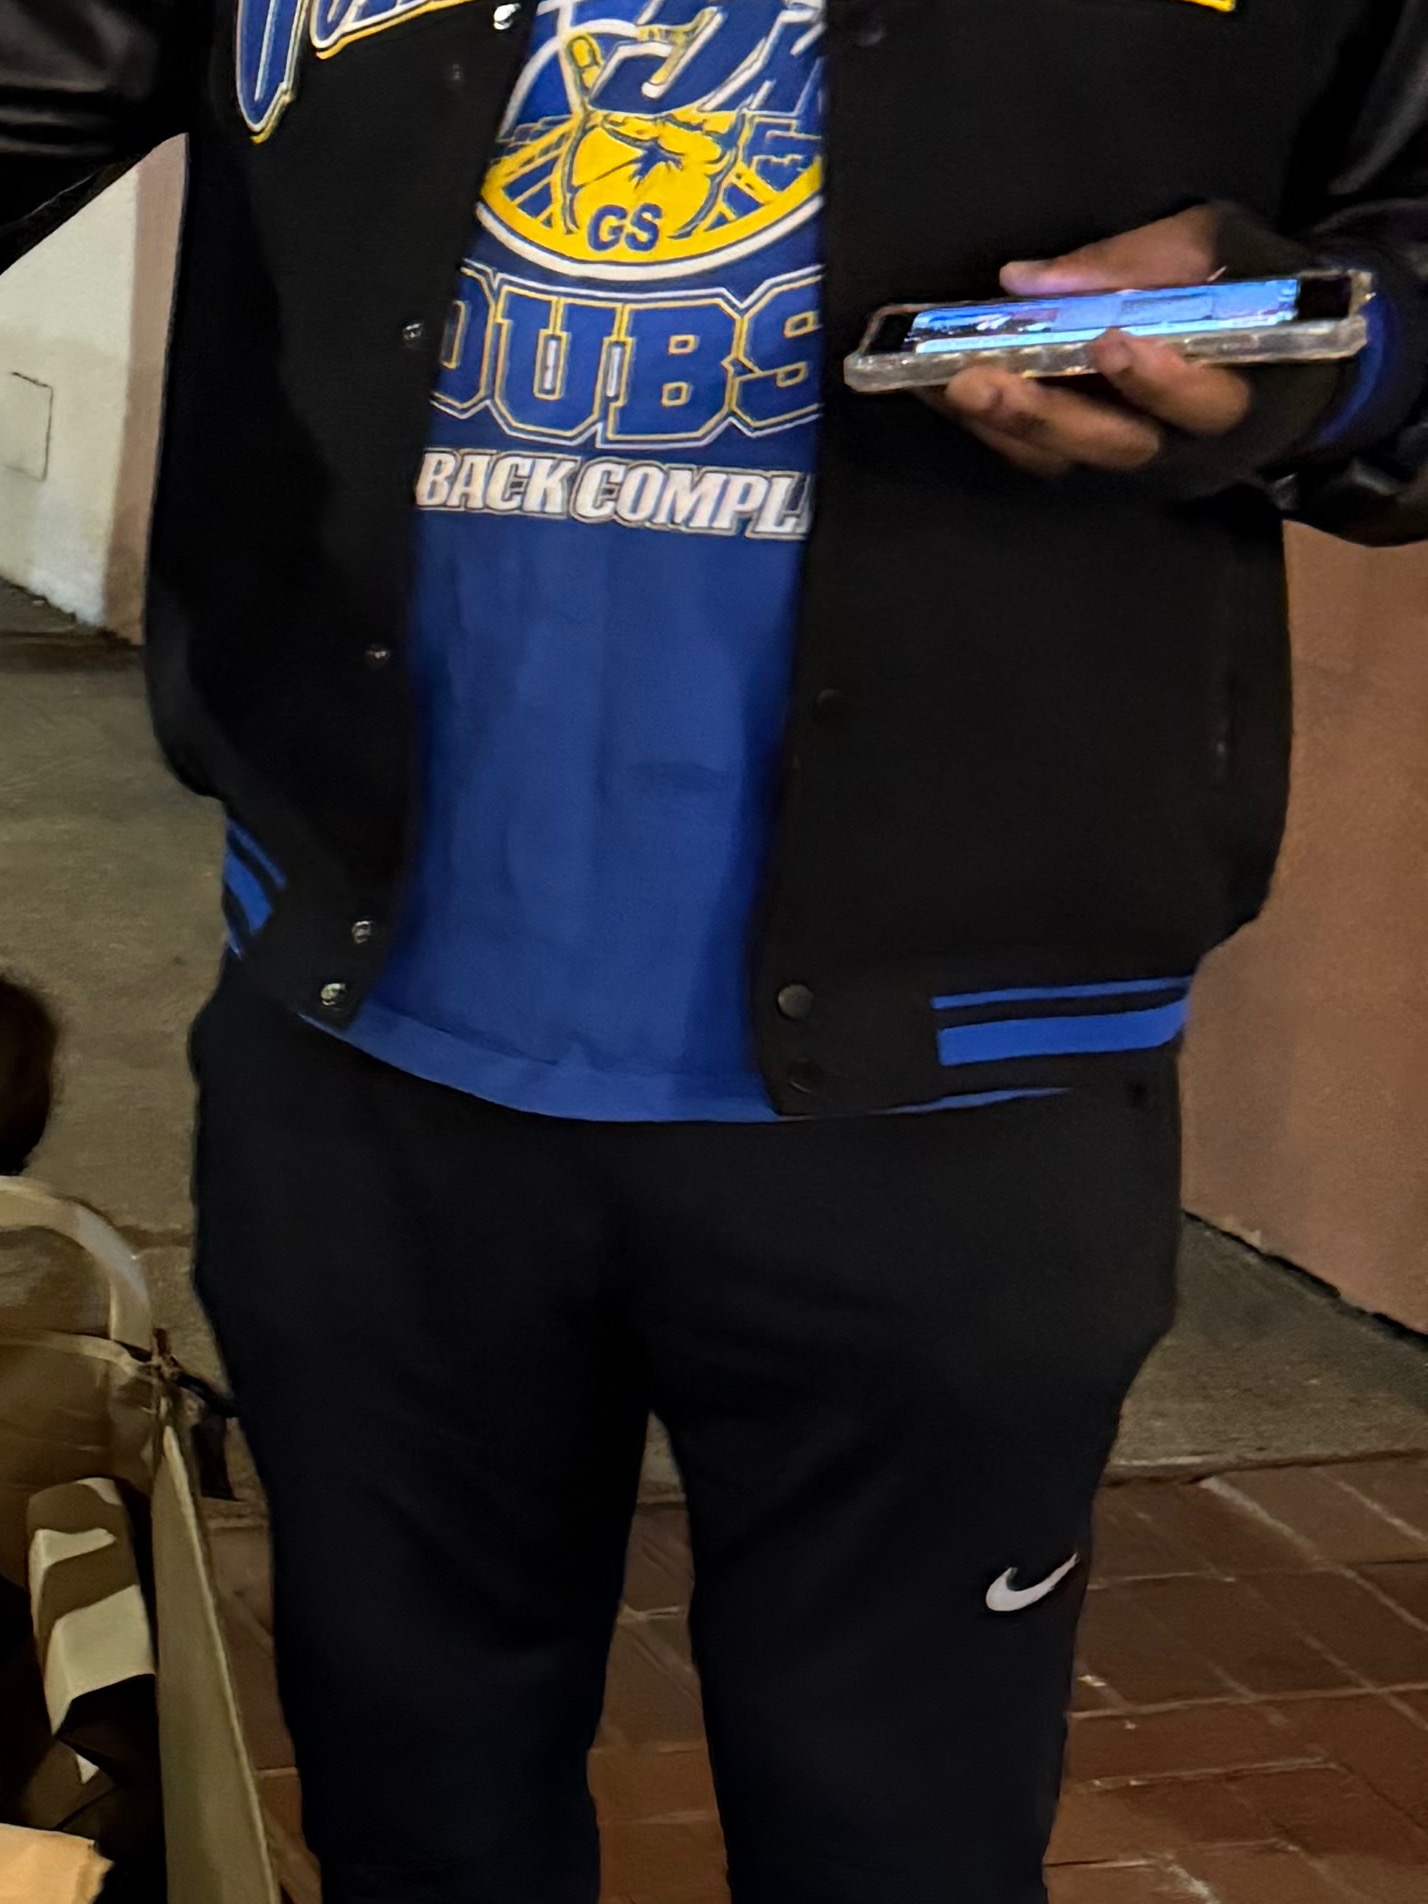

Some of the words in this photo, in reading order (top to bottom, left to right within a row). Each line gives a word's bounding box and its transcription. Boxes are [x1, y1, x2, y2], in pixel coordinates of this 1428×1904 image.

[587, 203, 664, 252] GS
[414, 448, 582, 518] BACK
[568, 456, 817, 540] COMPL
